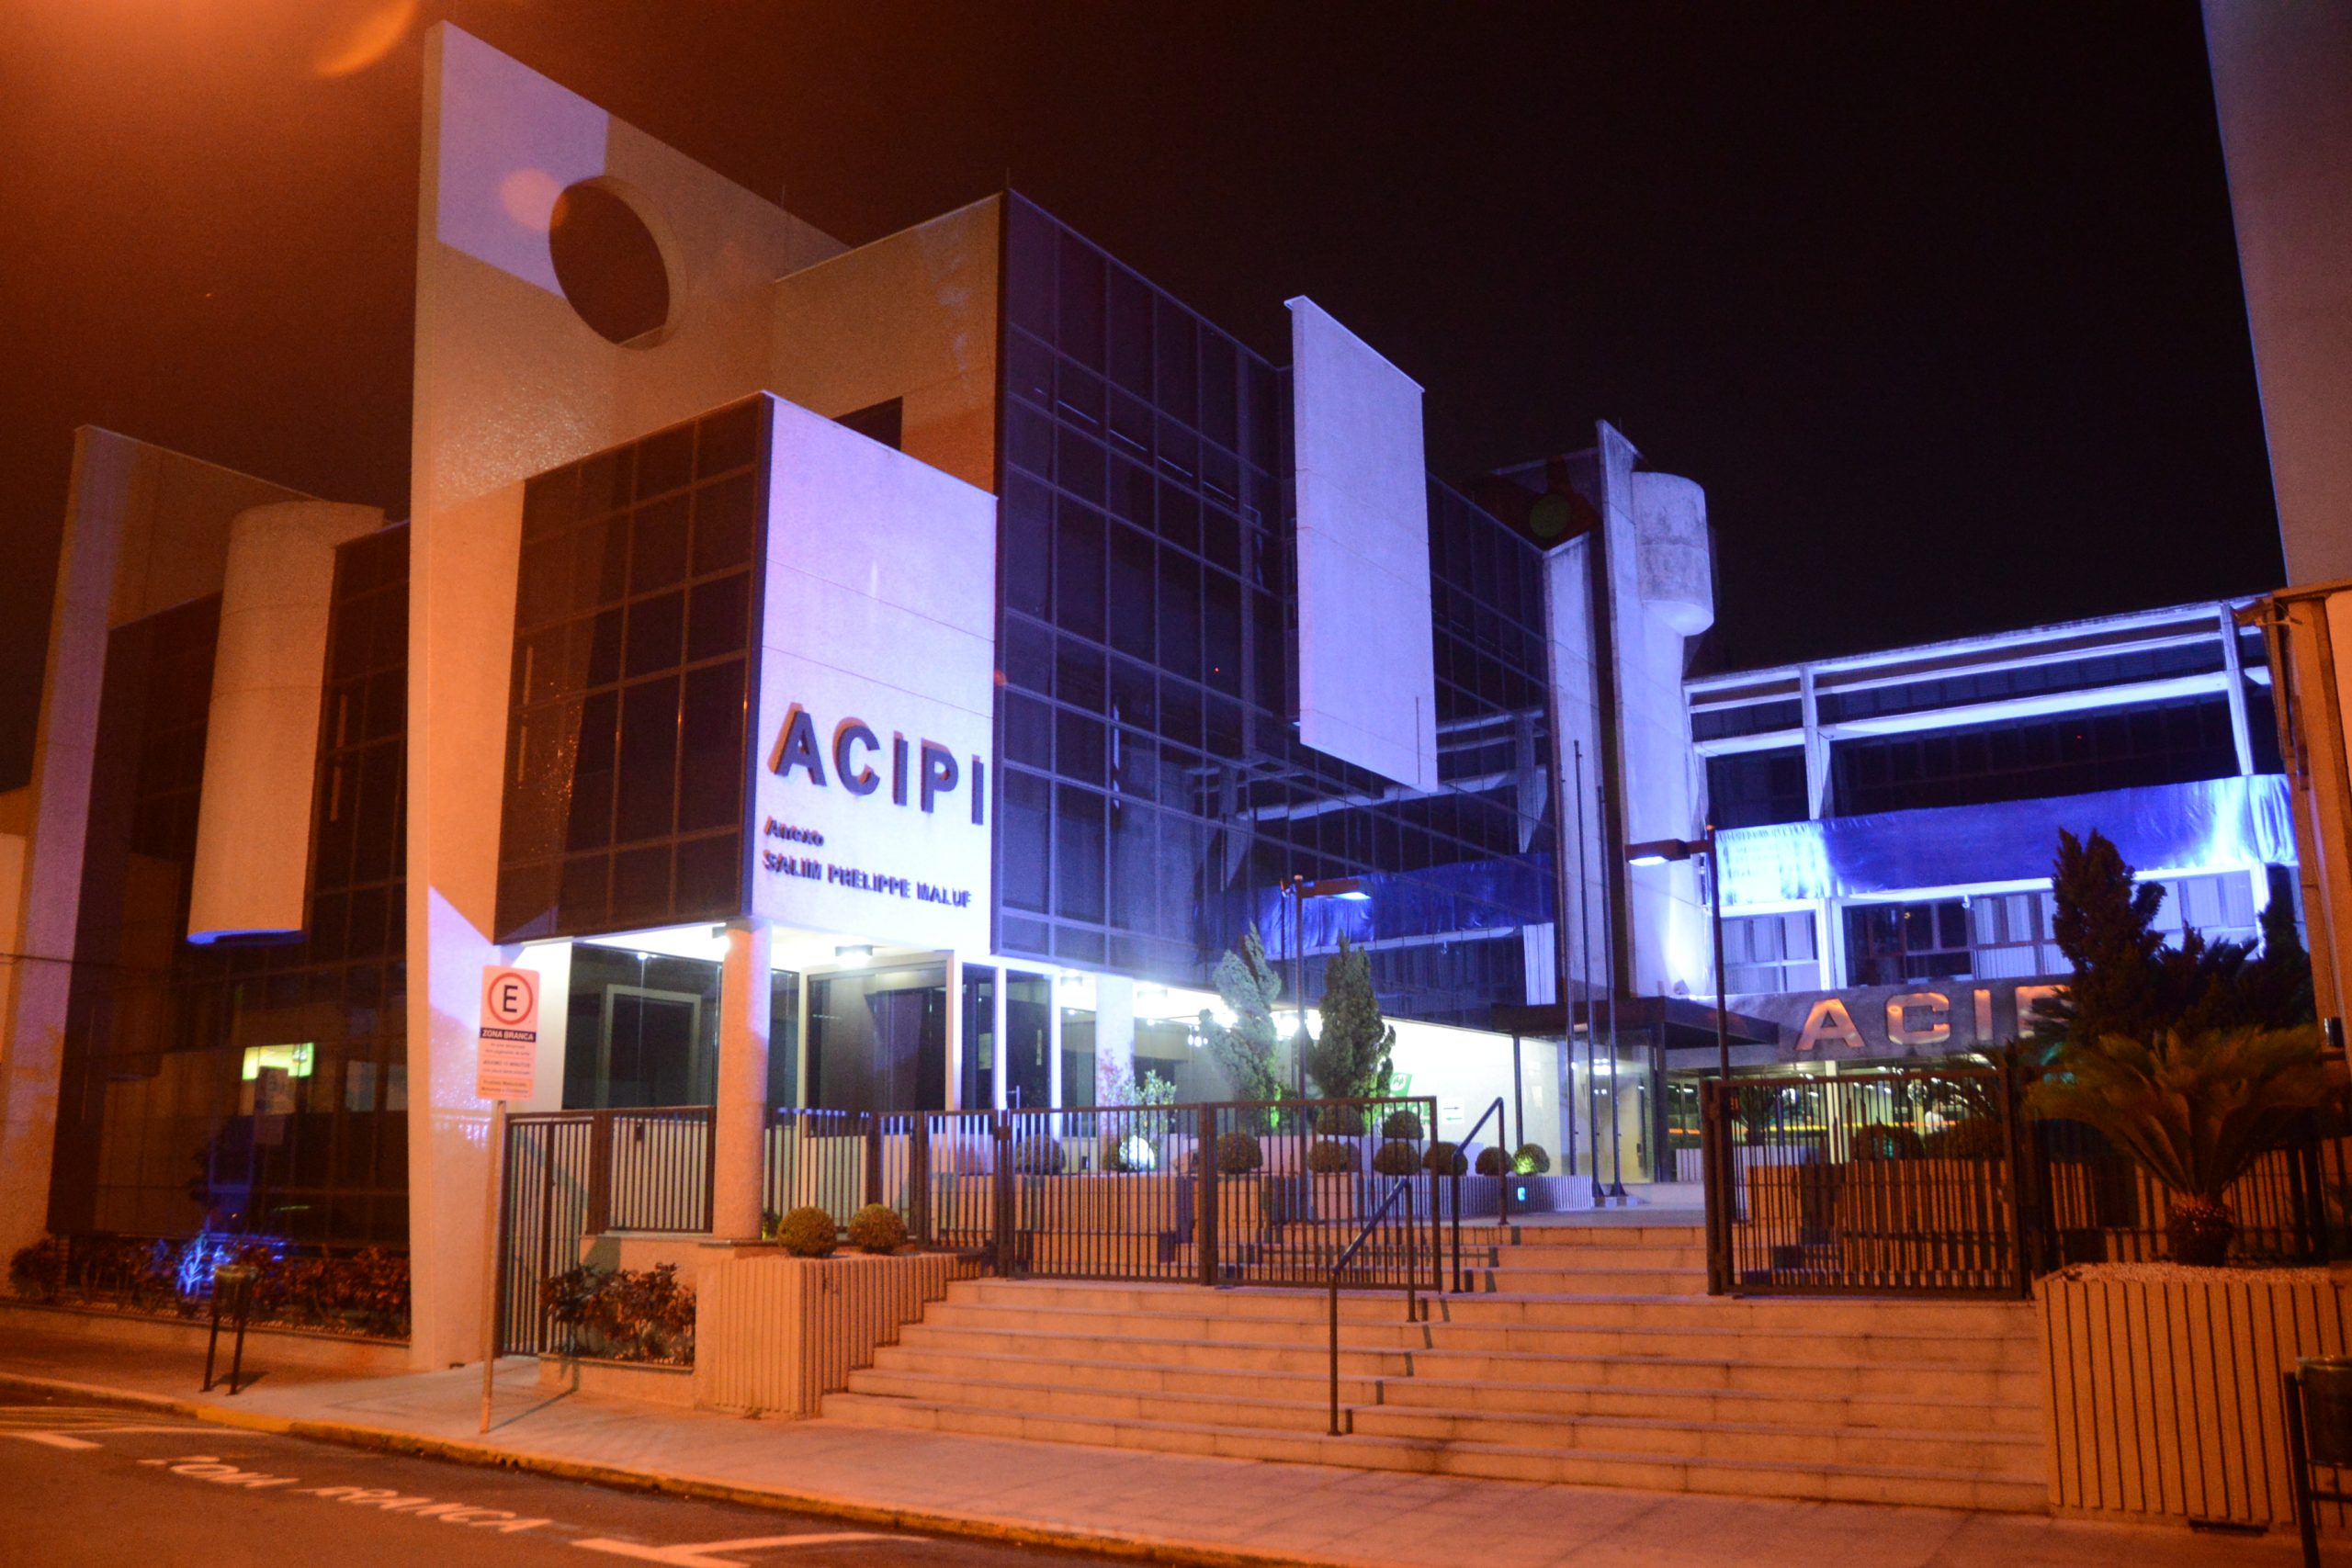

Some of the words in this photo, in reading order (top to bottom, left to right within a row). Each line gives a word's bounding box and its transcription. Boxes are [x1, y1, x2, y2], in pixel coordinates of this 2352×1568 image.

[768, 702, 984, 825] ACIPI
[763, 816, 825, 847] Anexo
[763, 849, 822, 880] SALIM
[828, 863, 911, 898] PHELIPPE
[917, 881, 972, 908] MALUF
[503, 985, 518, 1013] E
[481, 1029, 503, 1039] ZONA
[503, 1032, 534, 1041] BRANCA
